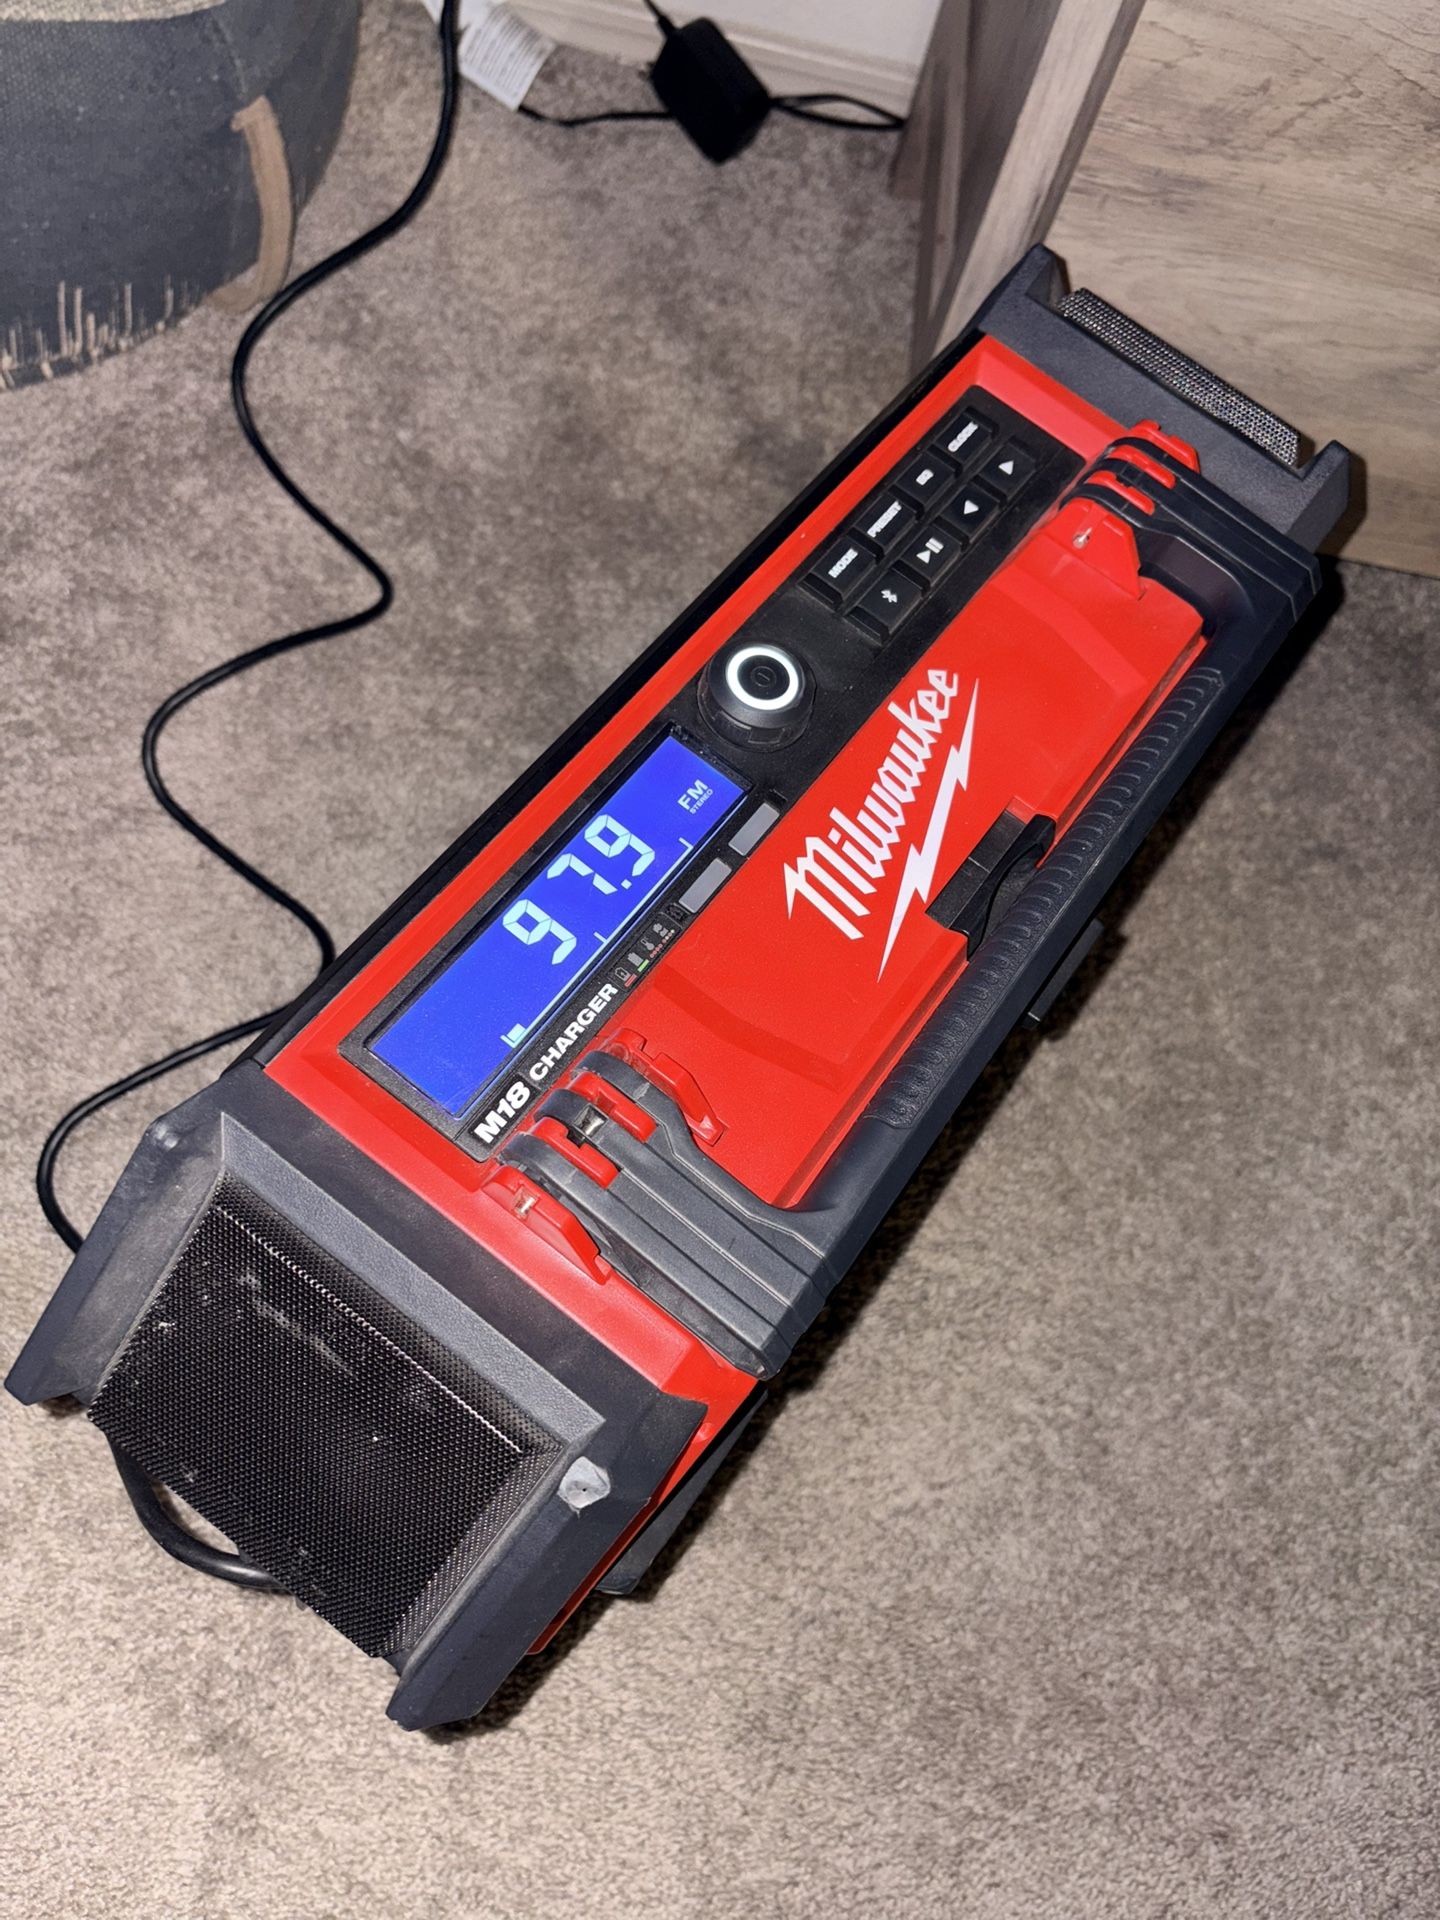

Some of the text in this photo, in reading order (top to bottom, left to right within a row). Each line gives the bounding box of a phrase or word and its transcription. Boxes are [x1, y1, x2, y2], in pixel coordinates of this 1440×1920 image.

[947, 421, 979, 453] CLOCK
[866, 500, 902, 538] PRESET
[828, 548, 859, 579] MODE
[677, 779, 709, 811] FM
[689, 788, 714, 814] STEREO
[783, 669, 959, 940] Milwaukee
[502, 814, 656, 966] 97.9
[473, 982, 619, 1144] M18 CHARGER
